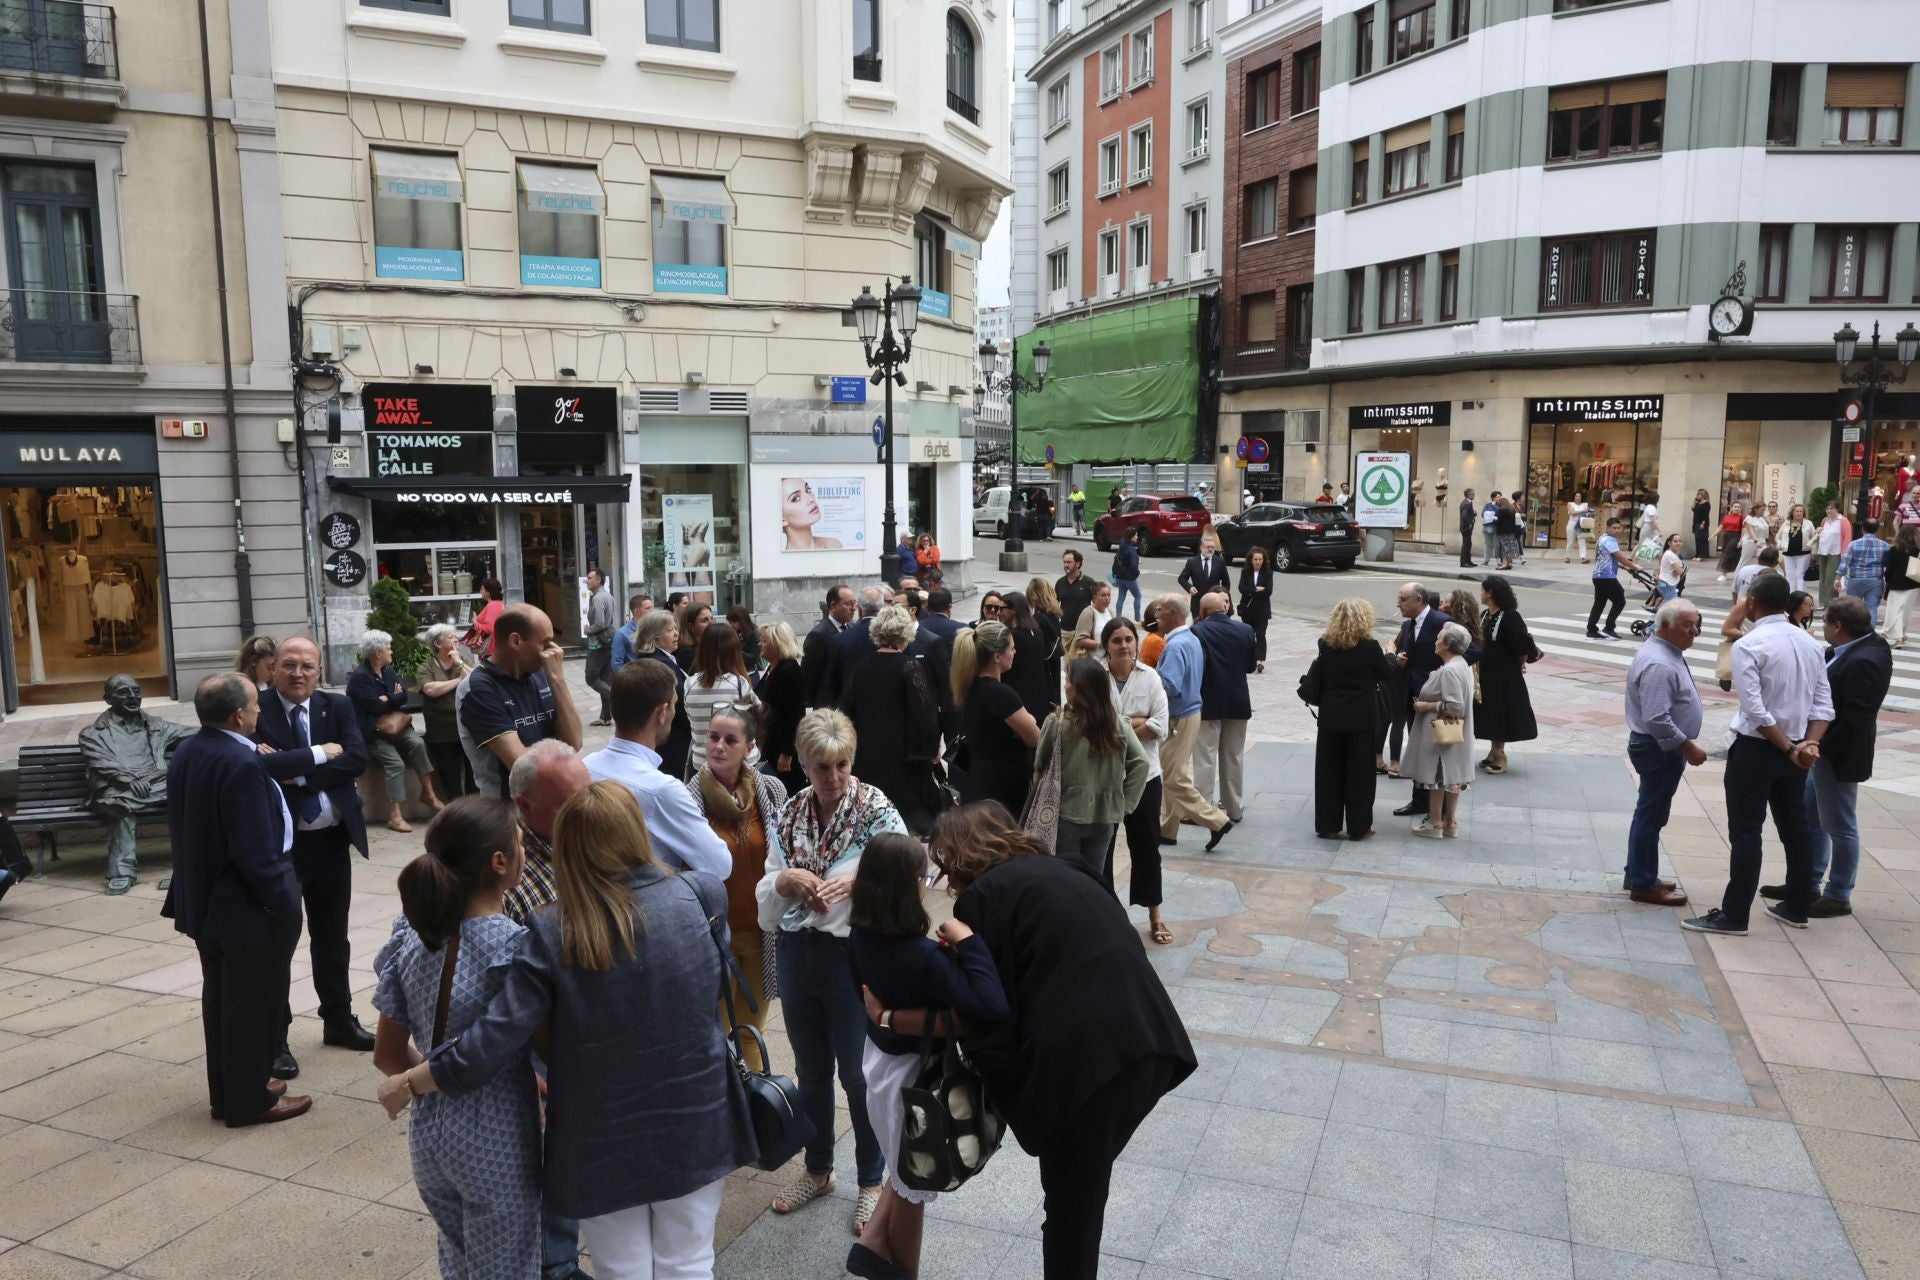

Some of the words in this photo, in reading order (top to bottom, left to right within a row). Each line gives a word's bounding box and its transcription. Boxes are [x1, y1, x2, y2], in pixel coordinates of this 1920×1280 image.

[528, 263, 556, 271] TERAPIA
[556, 264, 593, 273] INDUCCIÓN
[1636, 240, 1647, 295] NOTARIA
[1843, 235, 1853, 293] NOTARIA
[573, 274, 595, 282] FACIAL
[660, 270, 719, 280] RINOMODELACIÓN
[1550, 247, 1559, 300] NOTARIA
[656, 278, 692, 287] ELEVACIÓN
[692, 279, 724, 288] PÓMULOS
[374, 398, 418, 411] TAKE
[1536, 399, 1660, 412] intimissimi
[1363, 405, 1434, 418] intimissimi
[1584, 411, 1617, 420] Italian
[1619, 410, 1659, 421] lingerie
[1390, 417, 1409, 425] Italian
[1410, 416, 1433, 426] lingerie
[376, 435, 462, 448] TOMAMOS
[20, 448, 121, 461] MULAYA
[378, 449, 401, 461] LA
[378, 462, 434, 475] CALLE
[396, 493, 420, 502] NO
[422, 493, 466, 503] TODO
[468, 493, 489, 503] VA
[490, 493, 502, 503] A
[503, 493, 533, 503] SER
[534, 489, 572, 503] CAFÉ
[817, 486, 861, 496] BIOLIFTING
